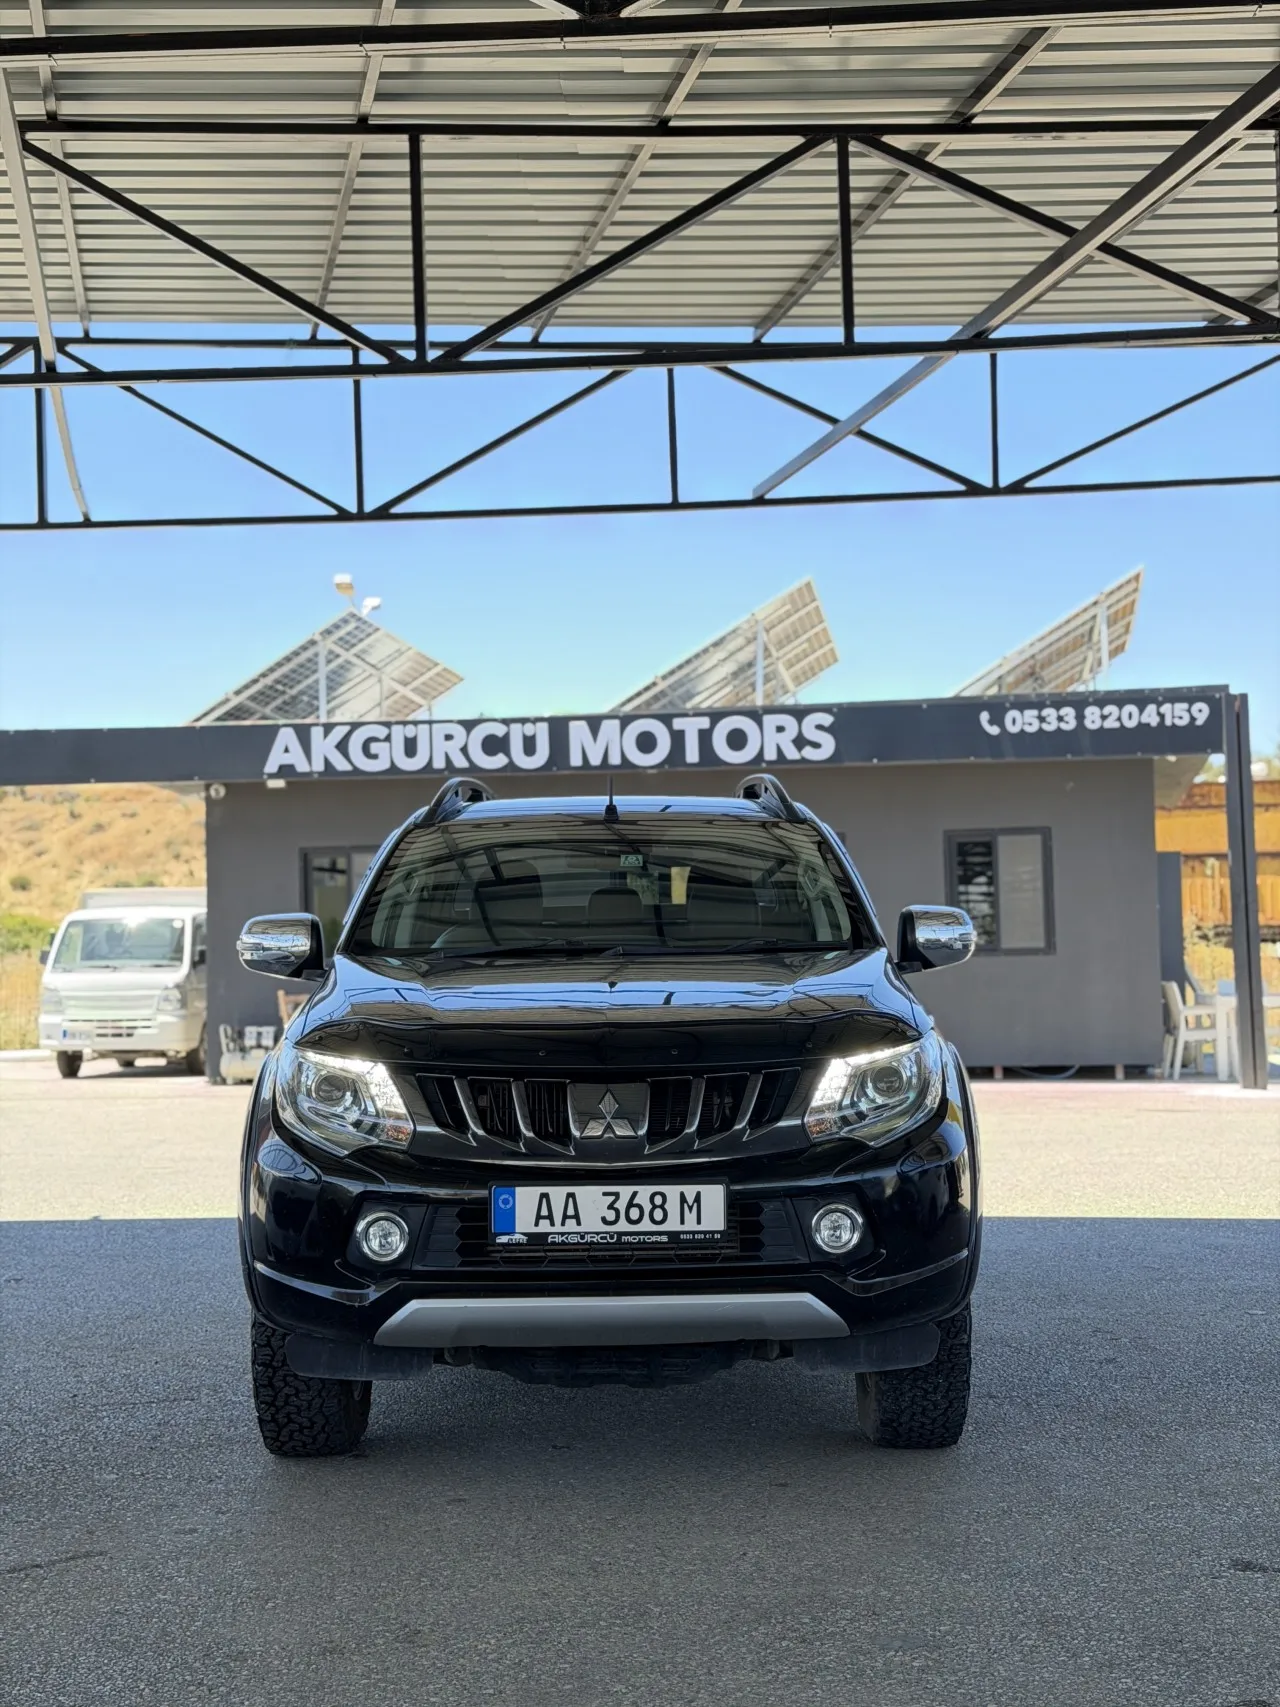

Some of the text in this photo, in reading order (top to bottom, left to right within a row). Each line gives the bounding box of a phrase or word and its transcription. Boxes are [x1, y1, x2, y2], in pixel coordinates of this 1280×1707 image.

[1004, 701, 1210, 734] 0533 8204159
[263, 712, 836, 773] AKGÜRCÜ MOTORS
[534, 1192, 582, 1227] AA
[547, 1232, 617, 1243] AKGÜRCÜ
